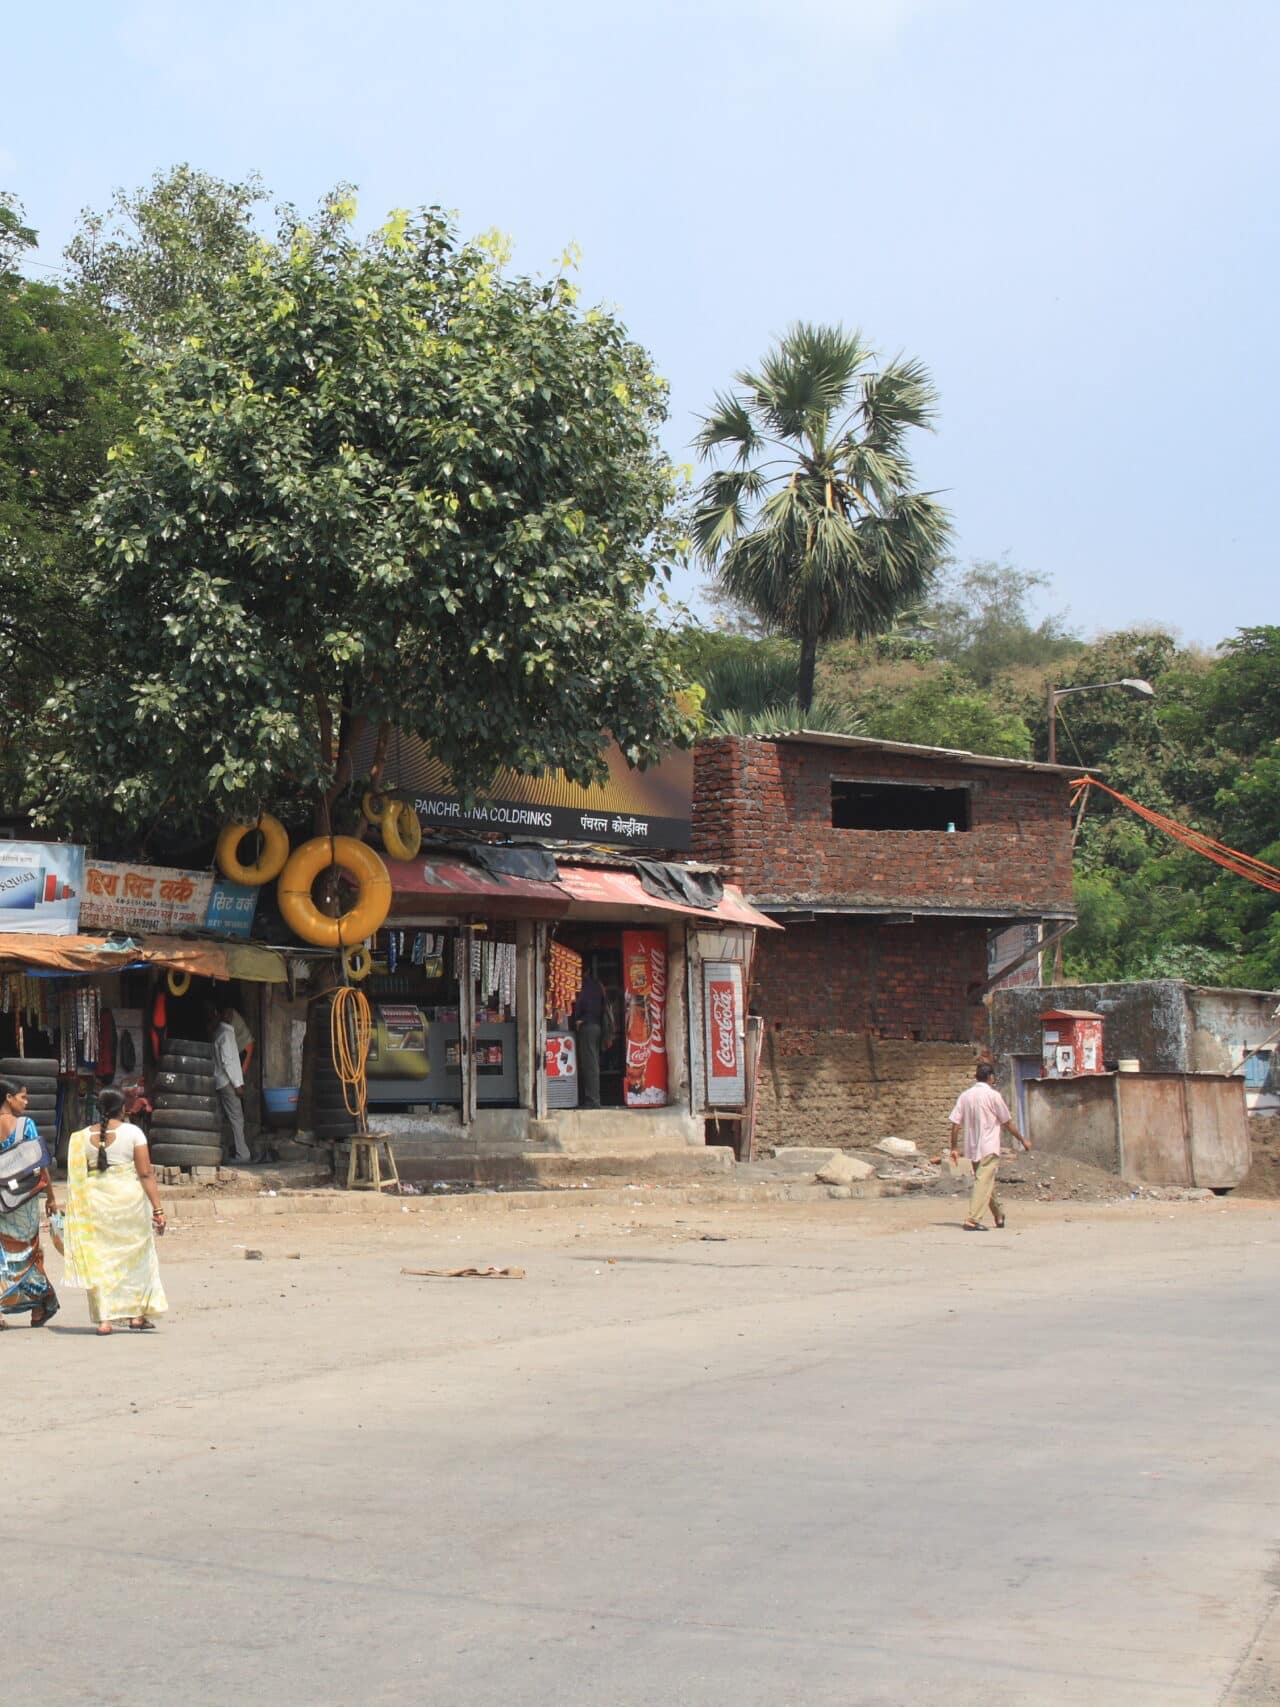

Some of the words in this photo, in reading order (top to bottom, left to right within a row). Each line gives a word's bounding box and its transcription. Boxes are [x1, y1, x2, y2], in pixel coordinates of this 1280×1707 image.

[414, 799, 488, 821] PANCHRNA
[490, 807, 552, 827] COLDRINKS
[123, 872, 157, 898] सिट
[159, 876, 198, 903] वर्क
[713, 986, 735, 1068] Coca-Cola
